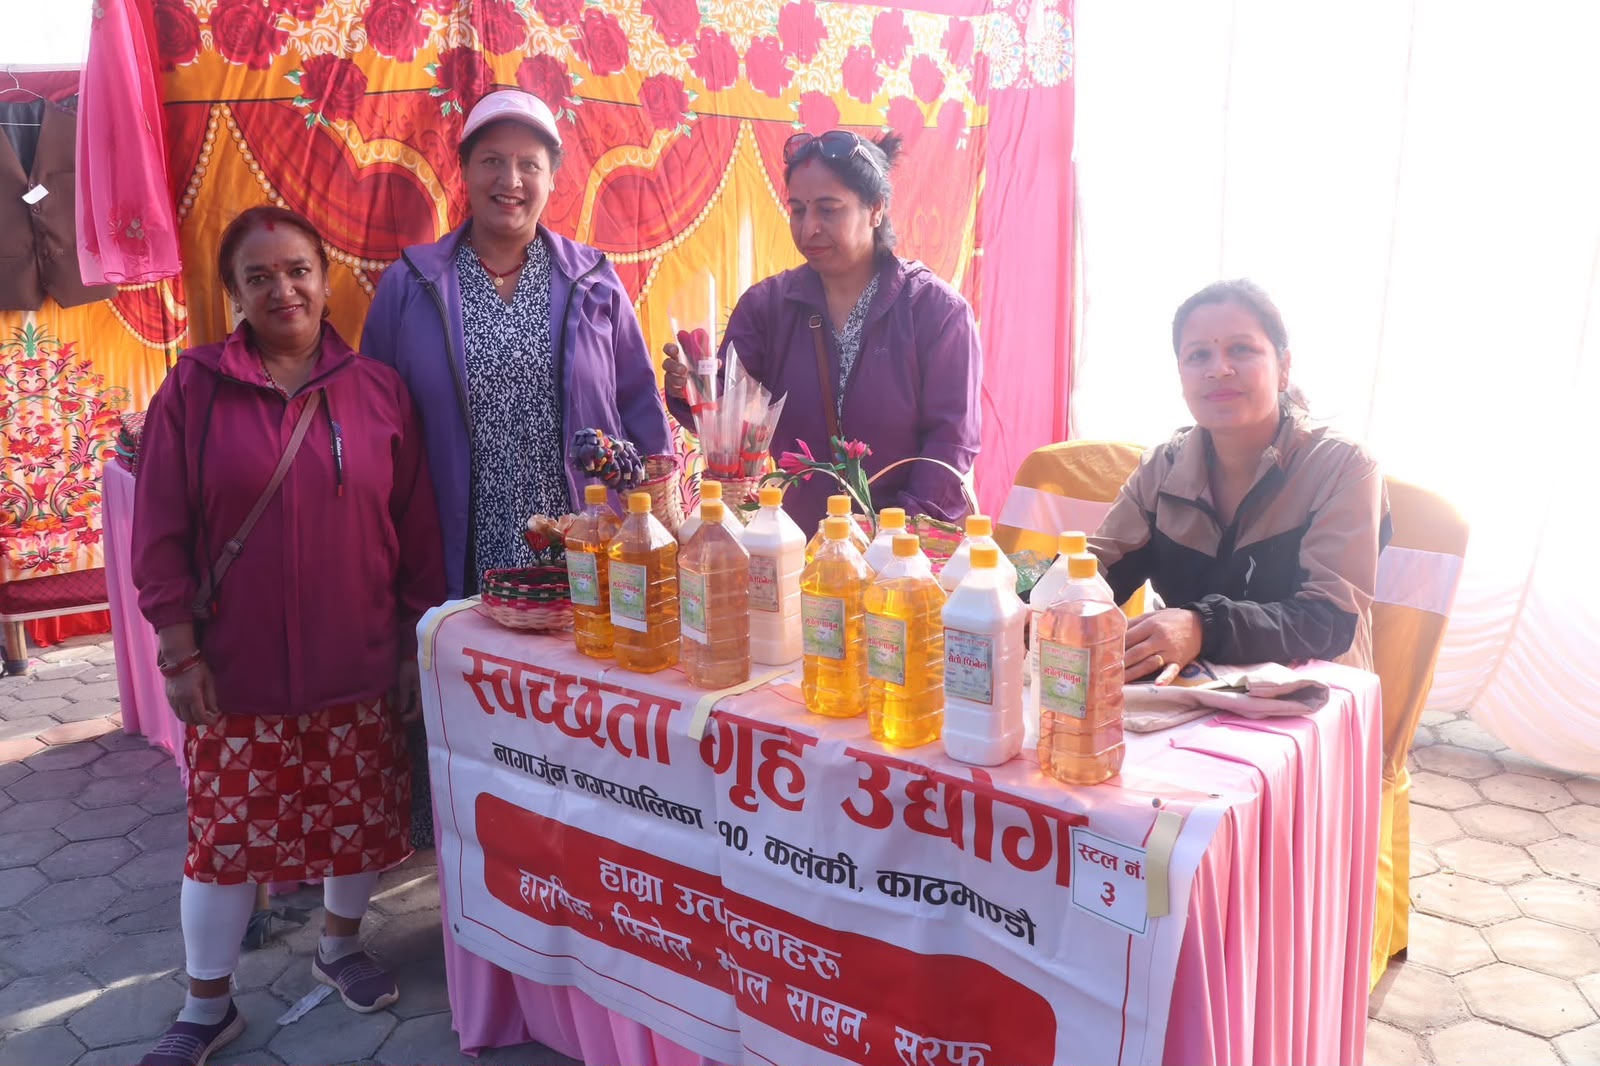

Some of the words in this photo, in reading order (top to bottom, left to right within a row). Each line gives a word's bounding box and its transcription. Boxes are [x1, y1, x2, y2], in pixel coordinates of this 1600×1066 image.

[462, 647, 682, 765] स्वच्छता
[699, 709, 819, 813] गृह
[840, 747, 1090, 888] उद्योग
[492, 742, 569, 786] नागार्जुन
[571, 769, 704, 829] नगरपालिका
[764, 835, 864, 893] कलंकी,
[876, 869, 1037, 946] काठमाण्डौ
[599, 857, 664, 906] हाम्रा
[1078, 842, 1119, 872] स्टल
[1124, 860, 1145, 880] नं.
[1100, 881, 1116, 907] ३
[611, 901, 703, 972] फिनेल,
[785, 983, 871, 1056] साबुन,
